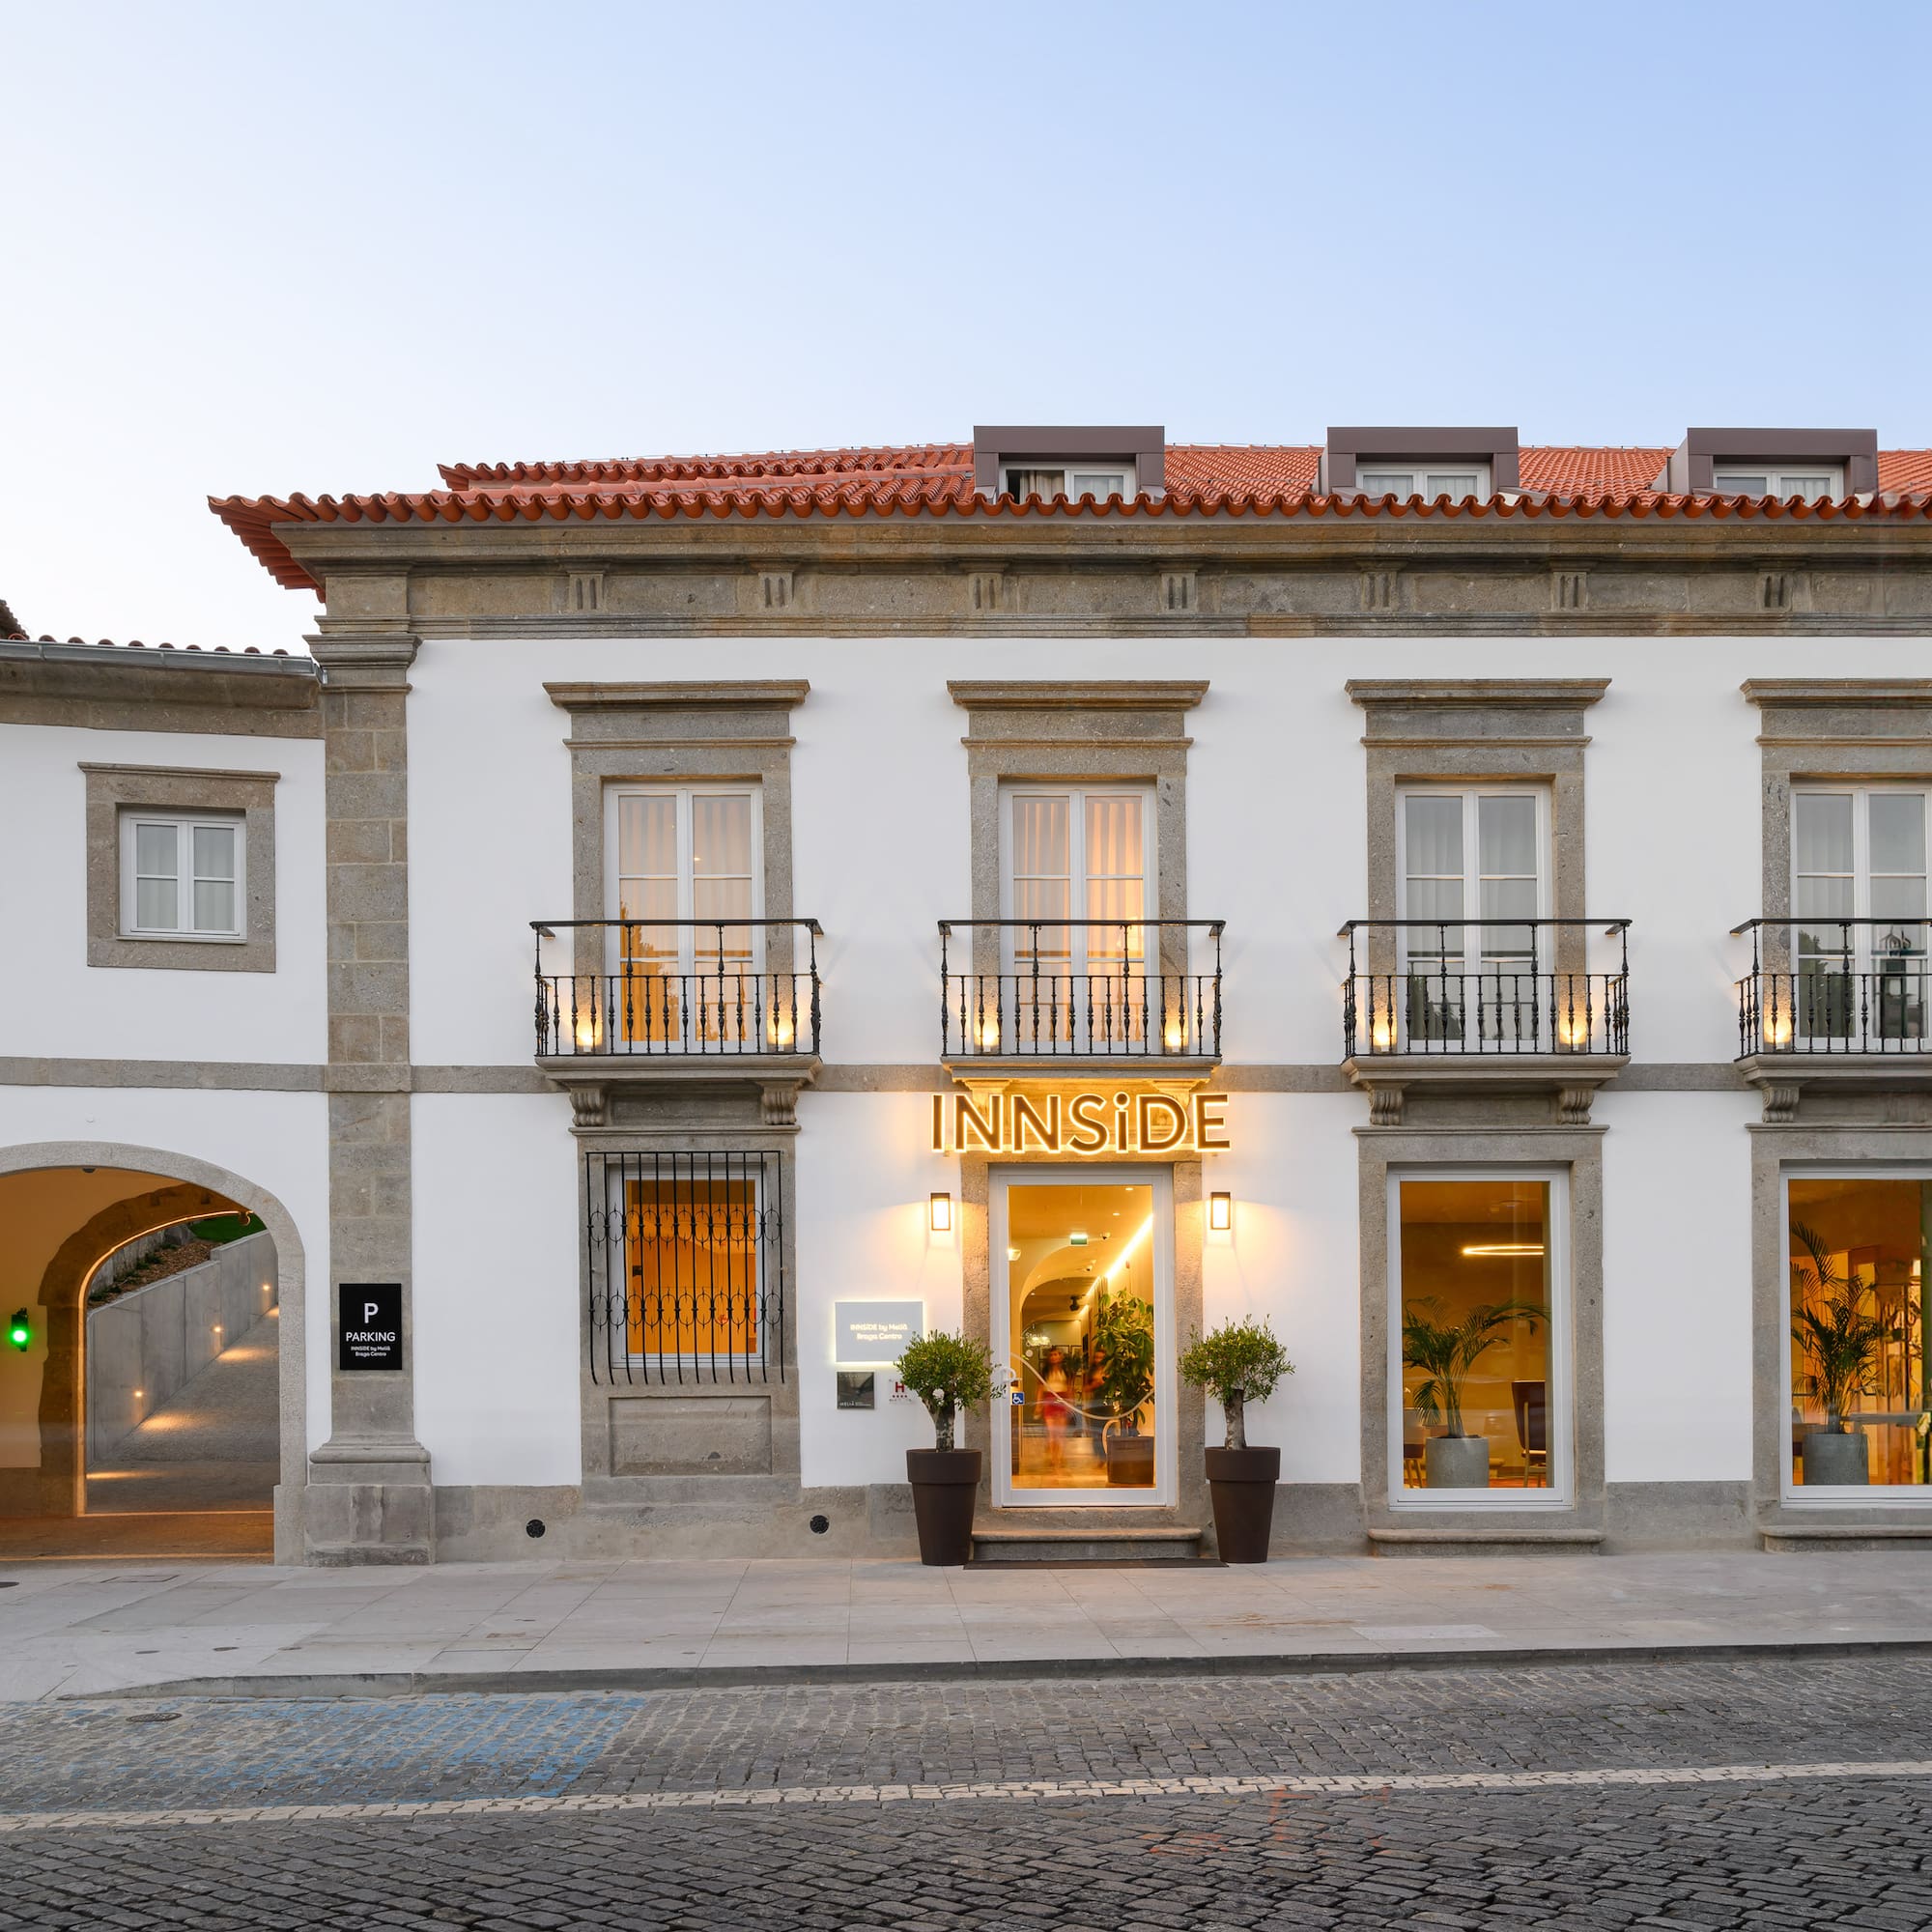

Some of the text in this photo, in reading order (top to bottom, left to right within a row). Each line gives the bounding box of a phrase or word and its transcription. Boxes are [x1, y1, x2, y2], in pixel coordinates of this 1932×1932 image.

[931, 1092, 1231, 1154] INNSiDE
[364, 1303, 379, 1323] P
[346, 1332, 396, 1342] PARKING
[895, 1381, 905, 1392] H
